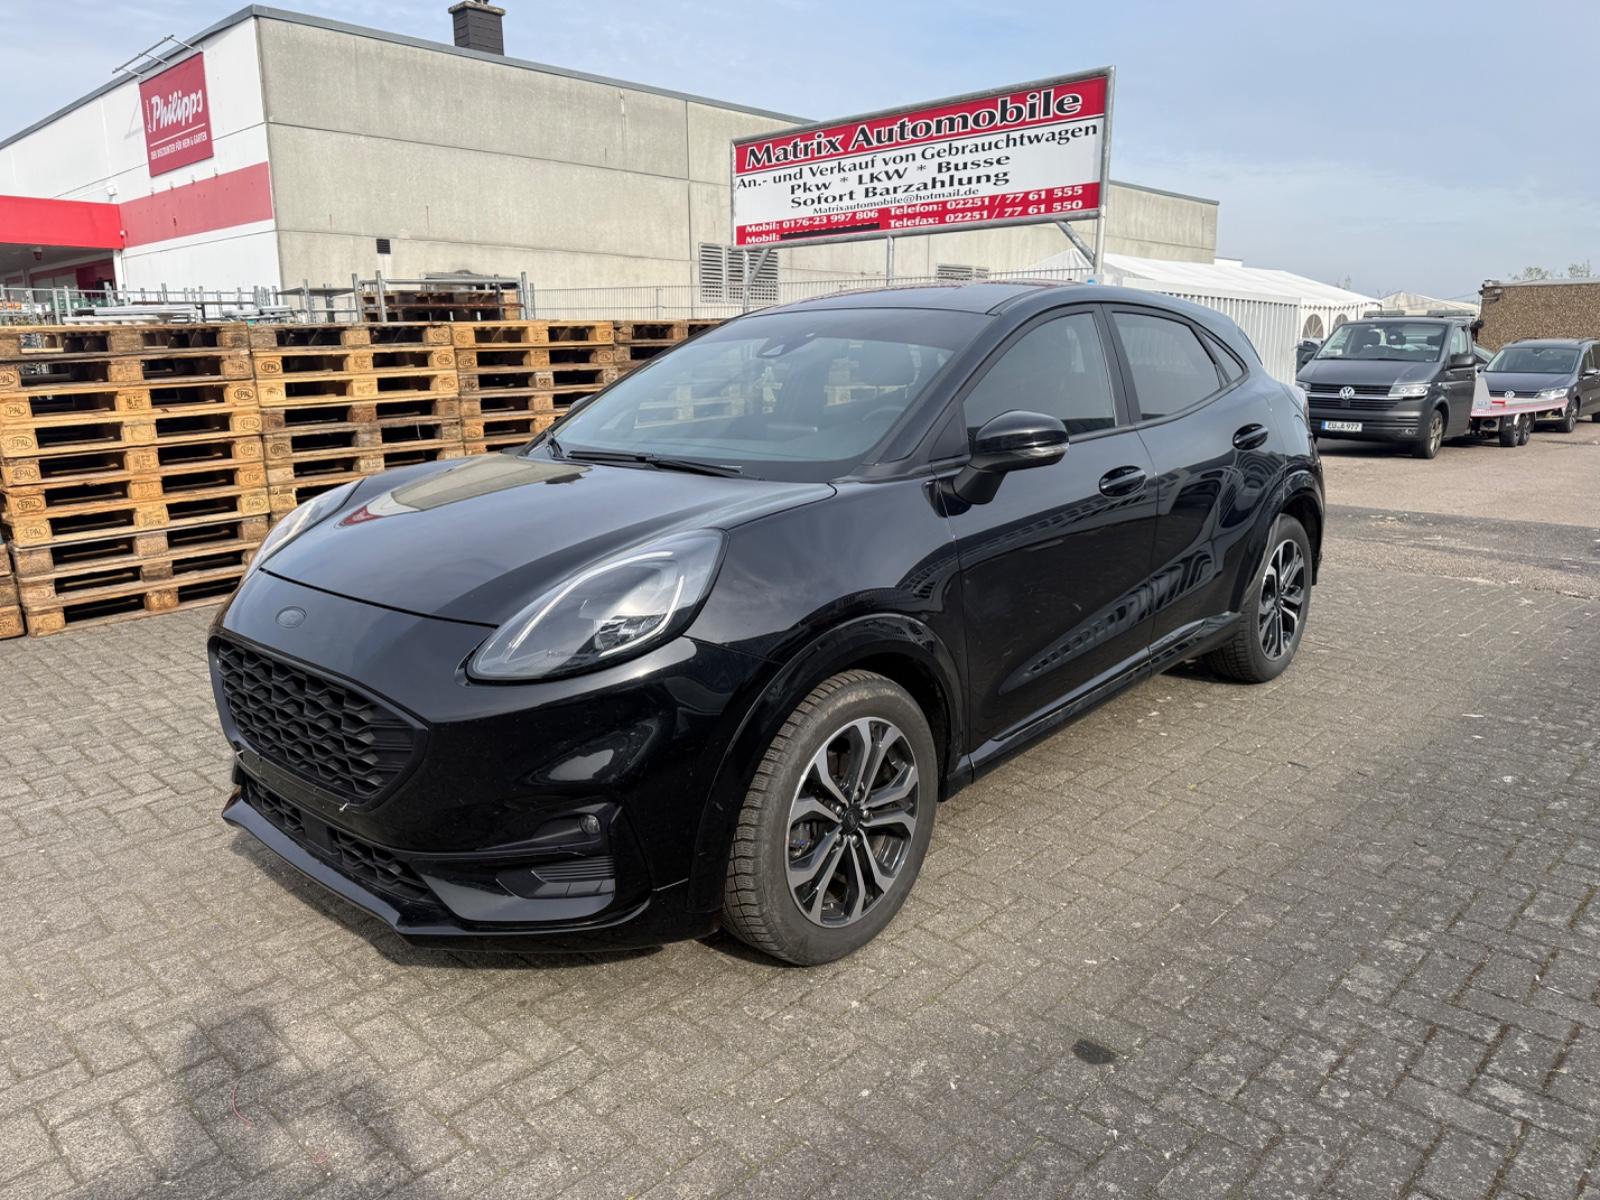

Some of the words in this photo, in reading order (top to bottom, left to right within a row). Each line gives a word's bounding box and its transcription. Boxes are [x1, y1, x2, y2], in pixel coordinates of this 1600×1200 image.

[151, 89, 203, 132] Philipps
[745, 133, 844, 169] Matrix
[848, 89, 1082, 151] Automobile
[773, 168, 803, 184] und
[808, 155, 877, 178] Verkauf
[882, 153, 916, 166] von
[921, 124, 1097, 160] Gebrauchtwagen
[790, 181, 832, 195] Pkw
[858, 167, 908, 185] LKW
[937, 155, 1010, 174] Busse
[791, 190, 856, 209] Sofort
[864, 171, 1010, 198] Barzahlung
[813, 187, 979, 214] Matrixautomobile@hotmail.de
[889, 203, 942, 216] Telefon:
[946, 197, 989, 210] 02251
[1005, 193, 1025, 204] 77
[1028, 190, 1046, 201] 61
[1053, 186, 1083, 198] 555
[889, 216, 939, 228] Telefax:
[945, 210, 988, 223] 02251
[1004, 206, 1023, 217] 77
[1027, 204, 1046, 214] 61
[1052, 200, 1083, 212] 550
[745, 222, 780, 233] Mobil:
[782, 216, 827, 228] 0176-23
[830, 213, 852, 223] 997
[855, 209, 879, 220] 806
[745, 233, 780, 244] Mobil:
